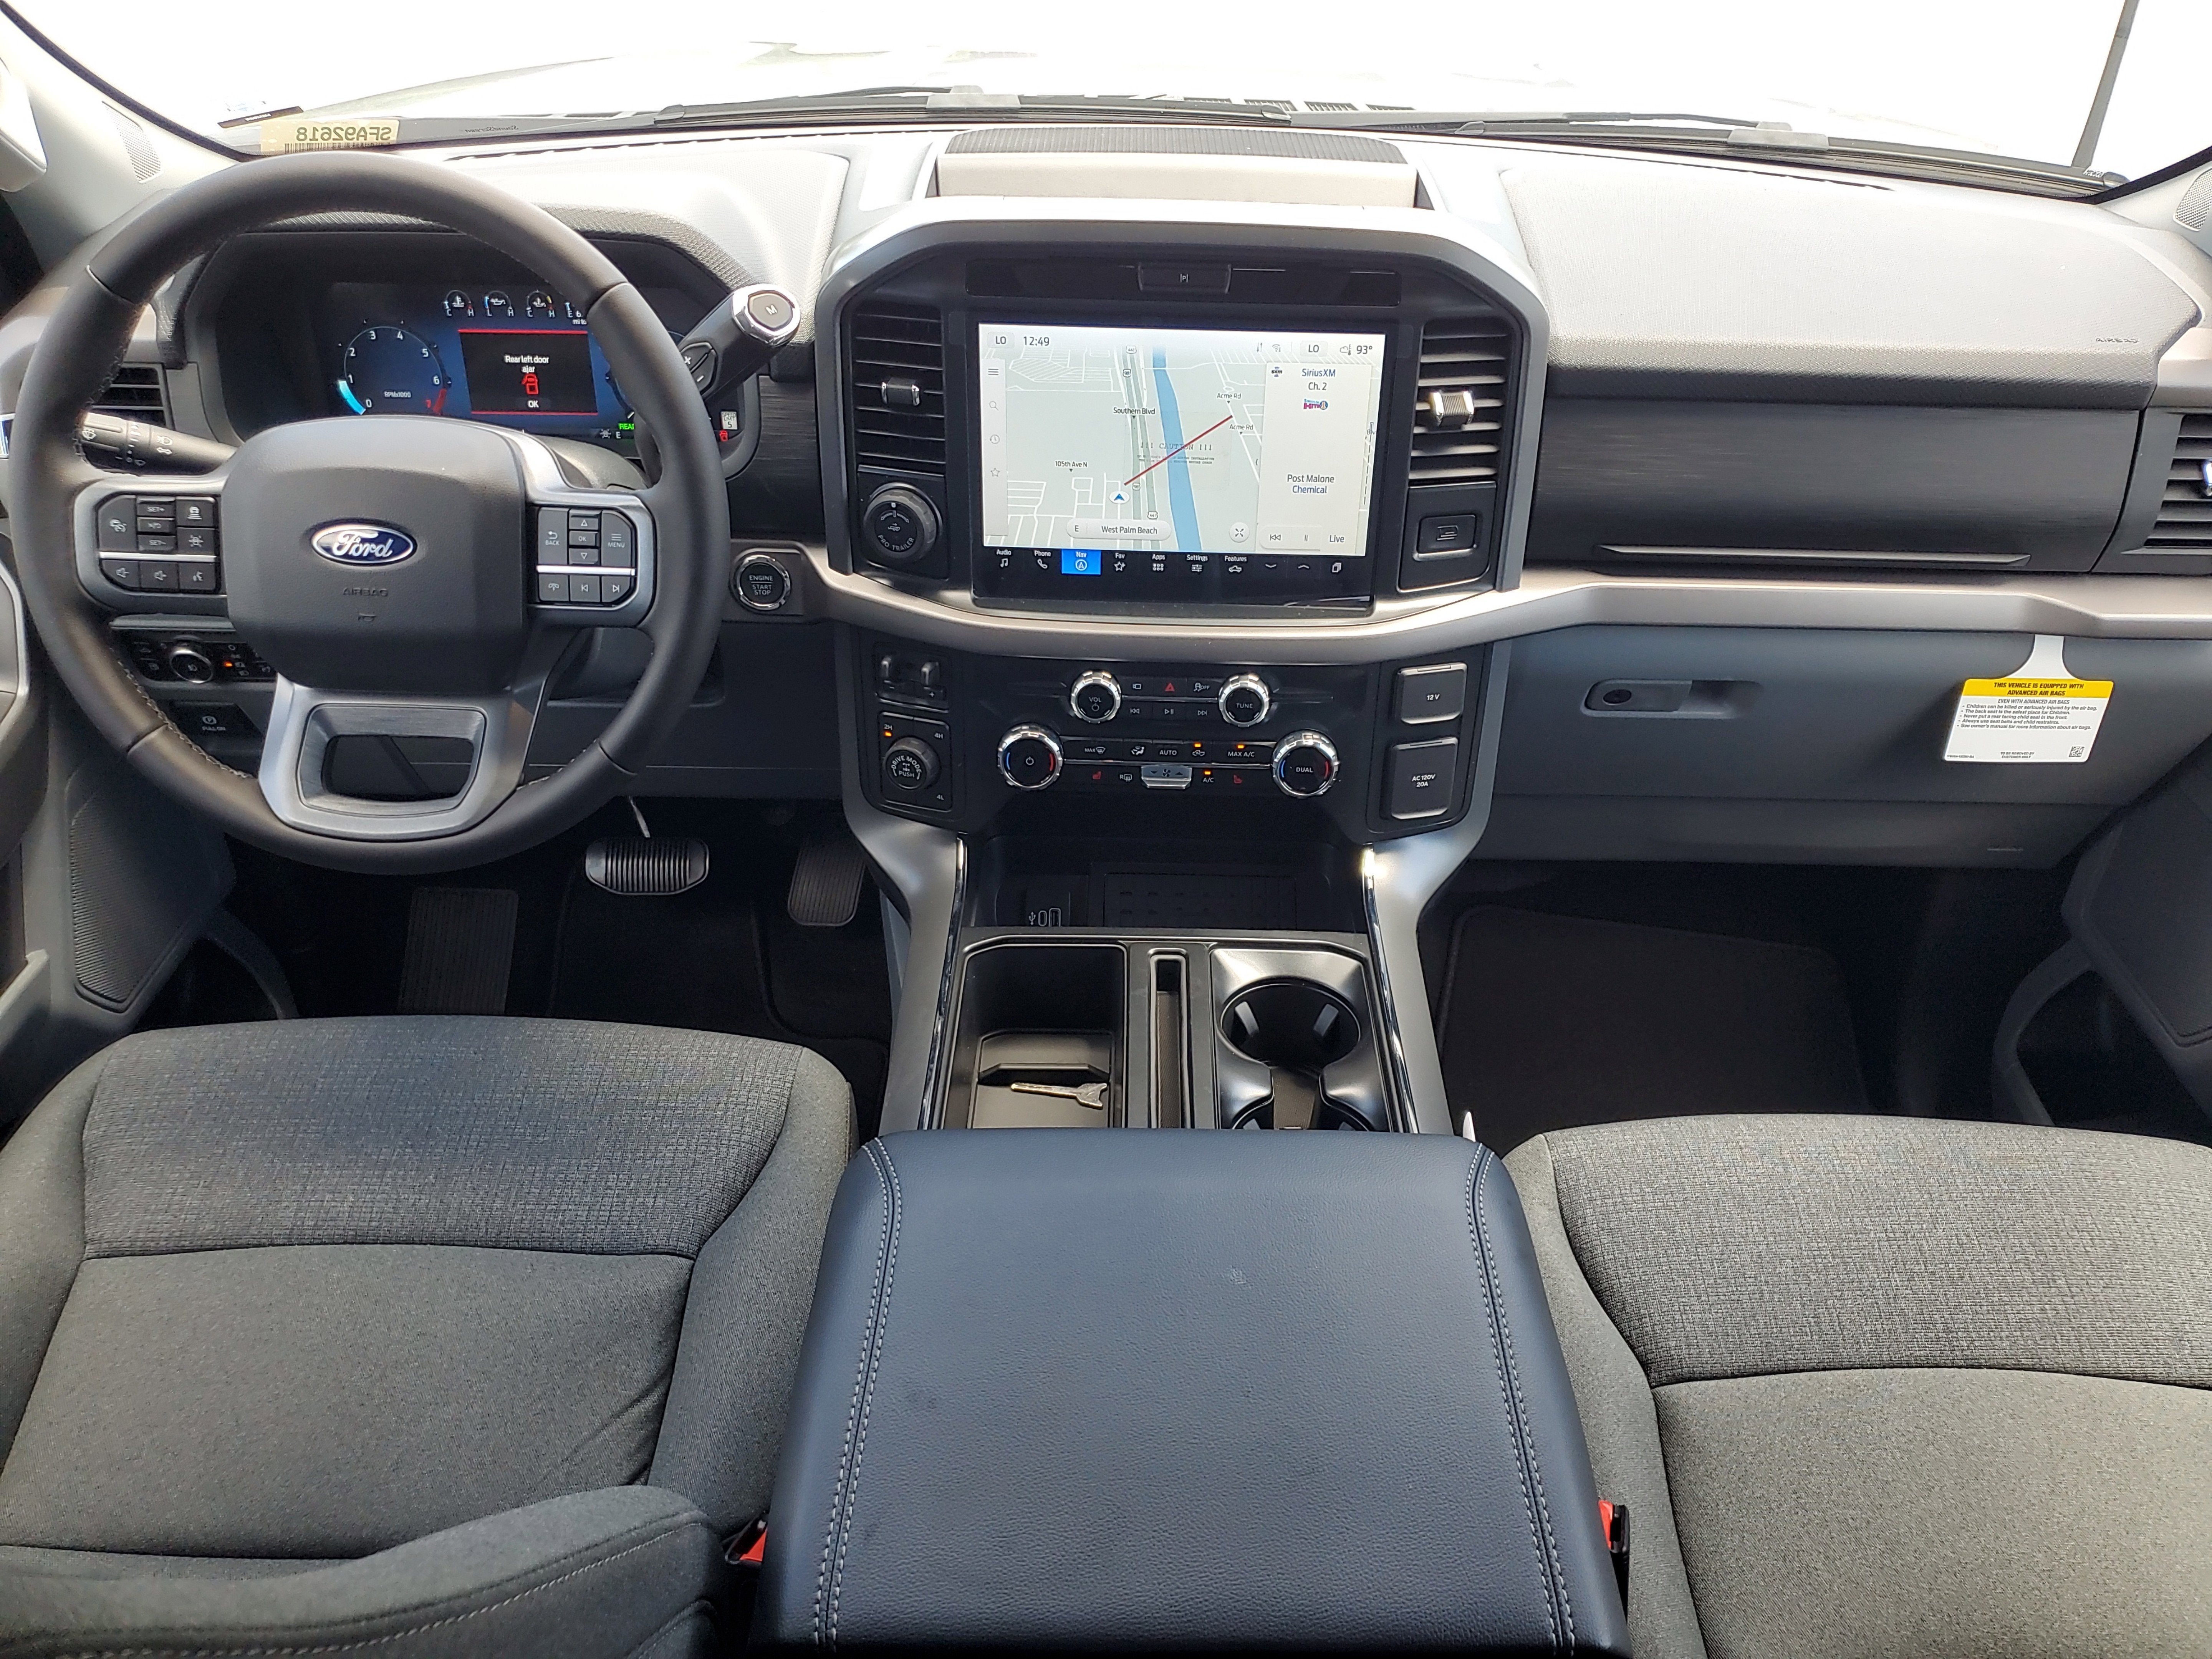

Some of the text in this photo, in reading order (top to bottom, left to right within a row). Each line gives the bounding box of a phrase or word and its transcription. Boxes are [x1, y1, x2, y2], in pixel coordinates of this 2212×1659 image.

[765, 304, 777, 315] M
[369, 331, 376, 340] 3
[397, 331, 403, 340] 4
[995, 336, 1007, 344] LO
[1023, 336, 1050, 346] 12:49
[349, 348, 356, 356] 2
[422, 348, 429, 357] 5
[1308, 344, 1319, 353] LO
[1356, 345, 1373, 354] 93°
[504, 354, 549, 363] Rear left door
[522, 365, 535, 374] ajar
[1302, 368, 1336, 377] SiriusXM
[348, 374, 353, 383] 1
[434, 376, 440, 384] 6
[1308, 382, 1327, 391] Ch. 2
[366, 399, 372, 408] 0
[1287, 474, 1334, 483] Post Malone
[1292, 485, 1327, 493] Chemical
[333, 530, 394, 557] Ford
[878, 535, 914, 551] PRO TRAILER
[891, 755, 922, 773] DRIVE MODE
